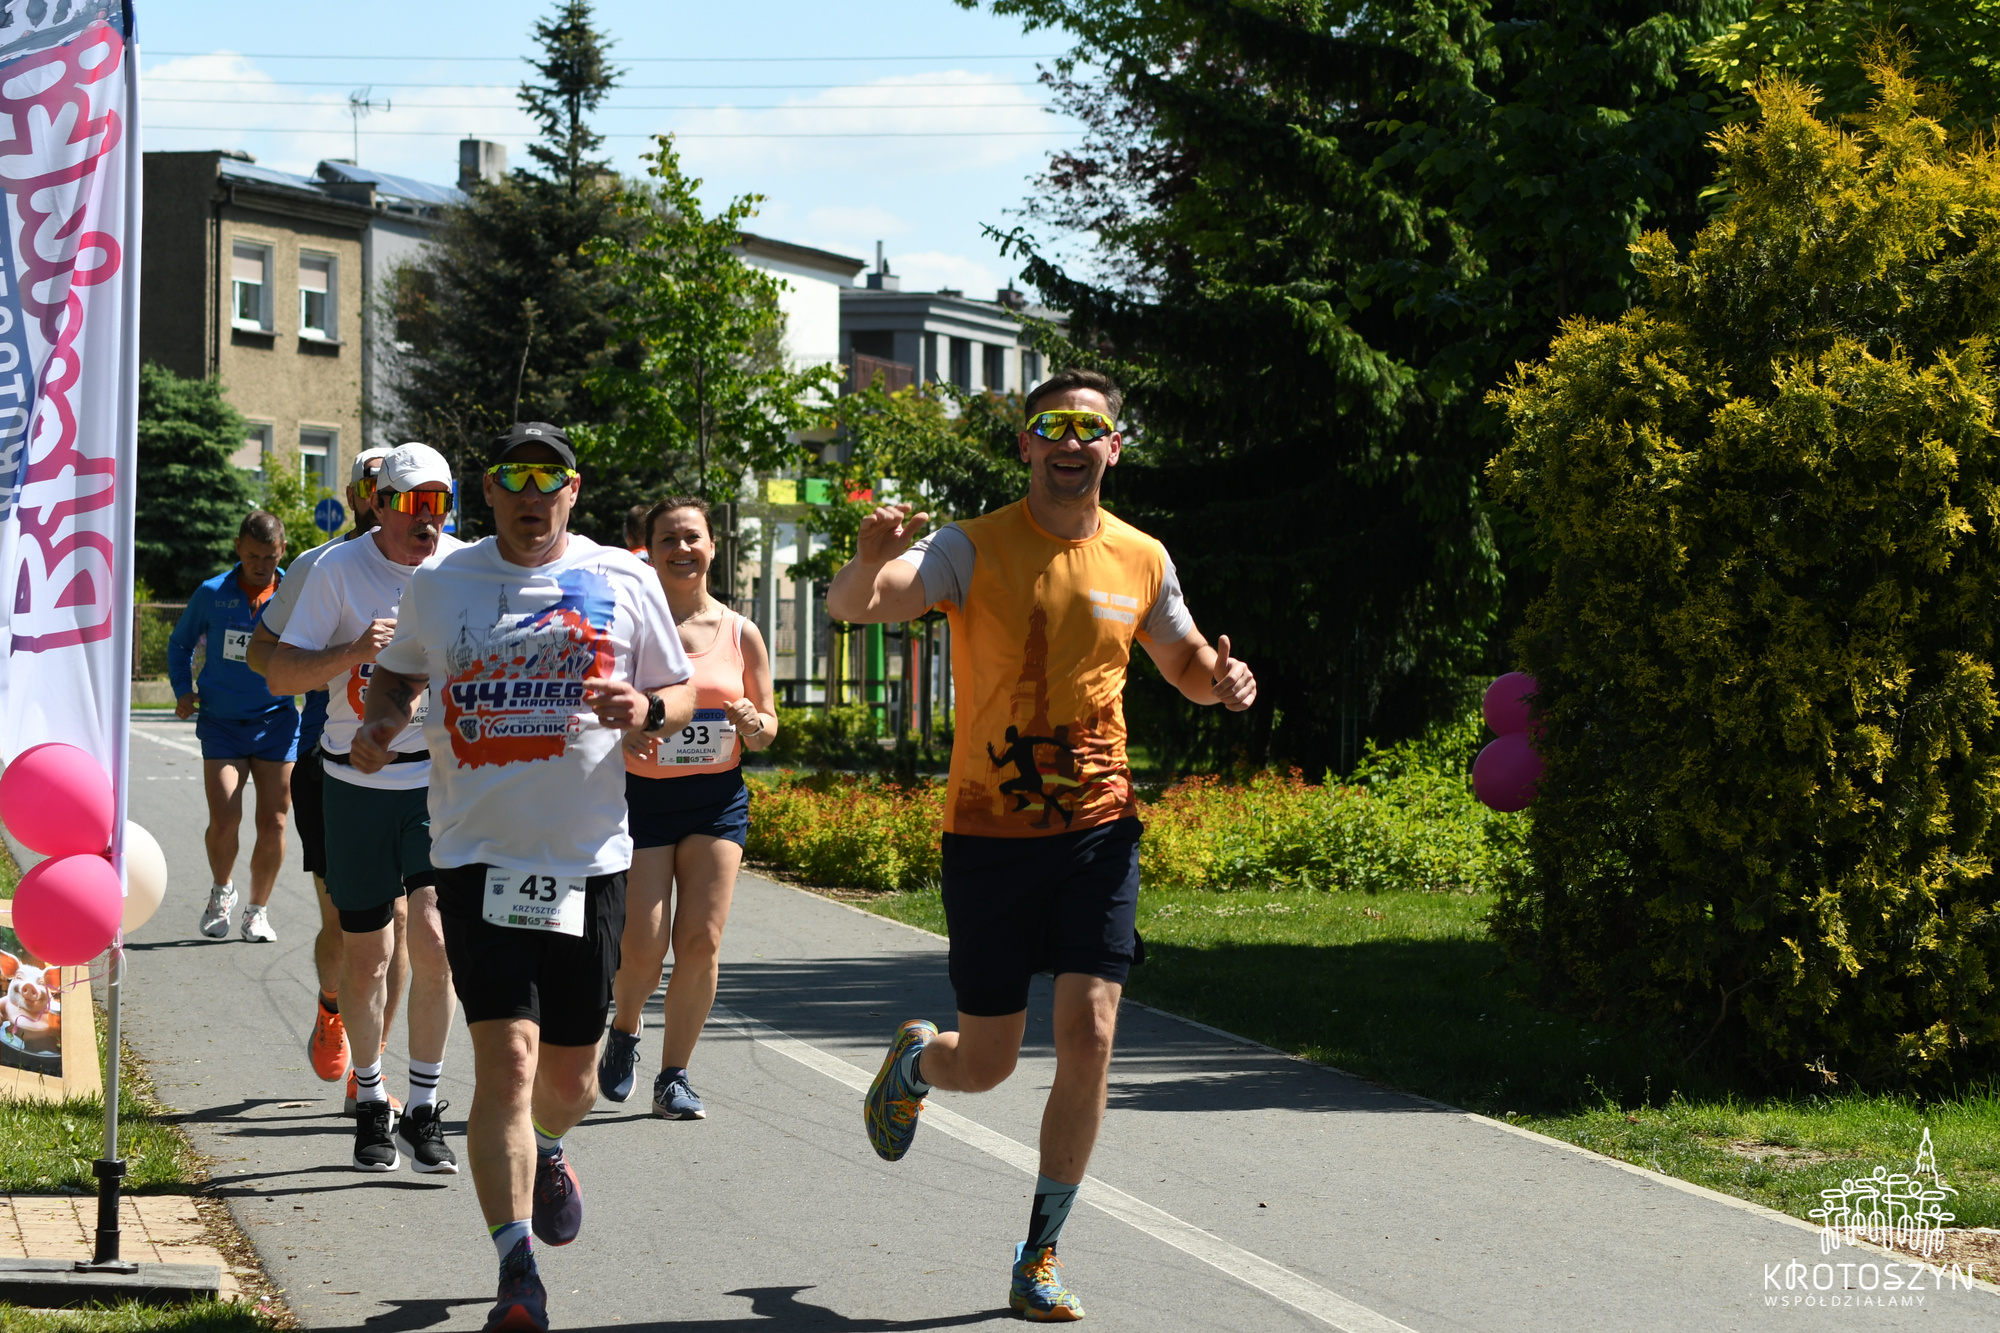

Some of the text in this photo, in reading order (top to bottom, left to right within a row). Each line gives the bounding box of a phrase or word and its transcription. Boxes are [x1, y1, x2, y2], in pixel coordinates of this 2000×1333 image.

[512, 682, 583, 699] BIEG
[520, 699, 581, 708] KROTOSA
[493, 724, 565, 734] WODNIK
[681, 725, 710, 745] 93
[519, 875, 556, 902] 43
